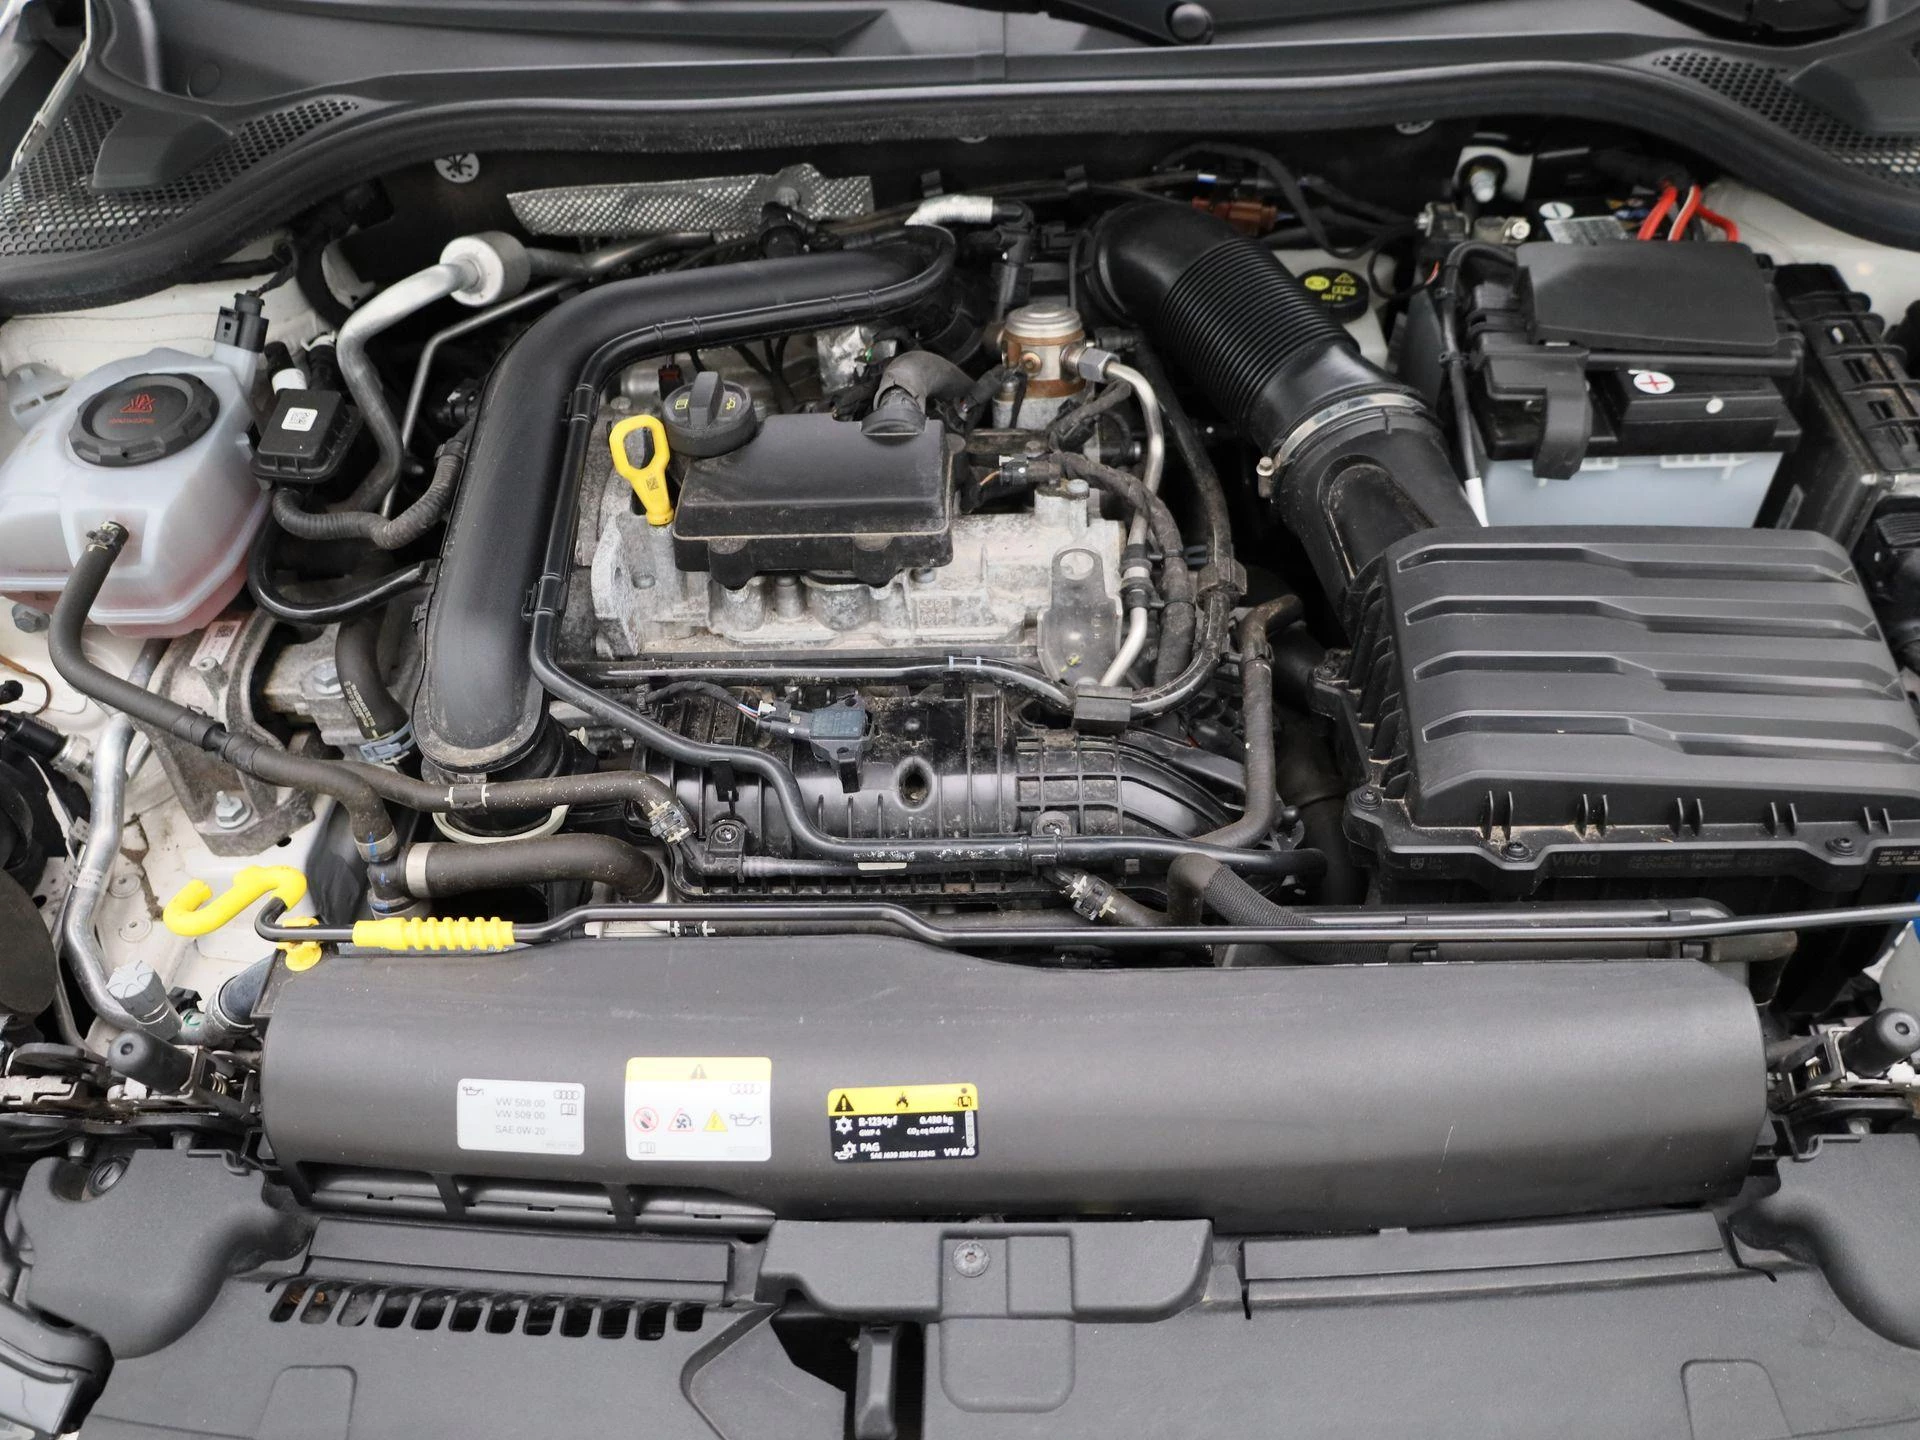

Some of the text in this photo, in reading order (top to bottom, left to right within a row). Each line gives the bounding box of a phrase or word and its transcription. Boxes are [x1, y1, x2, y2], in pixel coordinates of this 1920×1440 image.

[495, 1097, 546, 1108] VW 508 00
[495, 1110, 546, 1120] VW 509 00
[943, 1115, 954, 1126] kg
[858, 1115, 898, 1128] R-1234yf
[495, 1125, 514, 1135] SAE
[859, 1142, 880, 1153] PAG
[944, 1147, 976, 1157] VW AG
